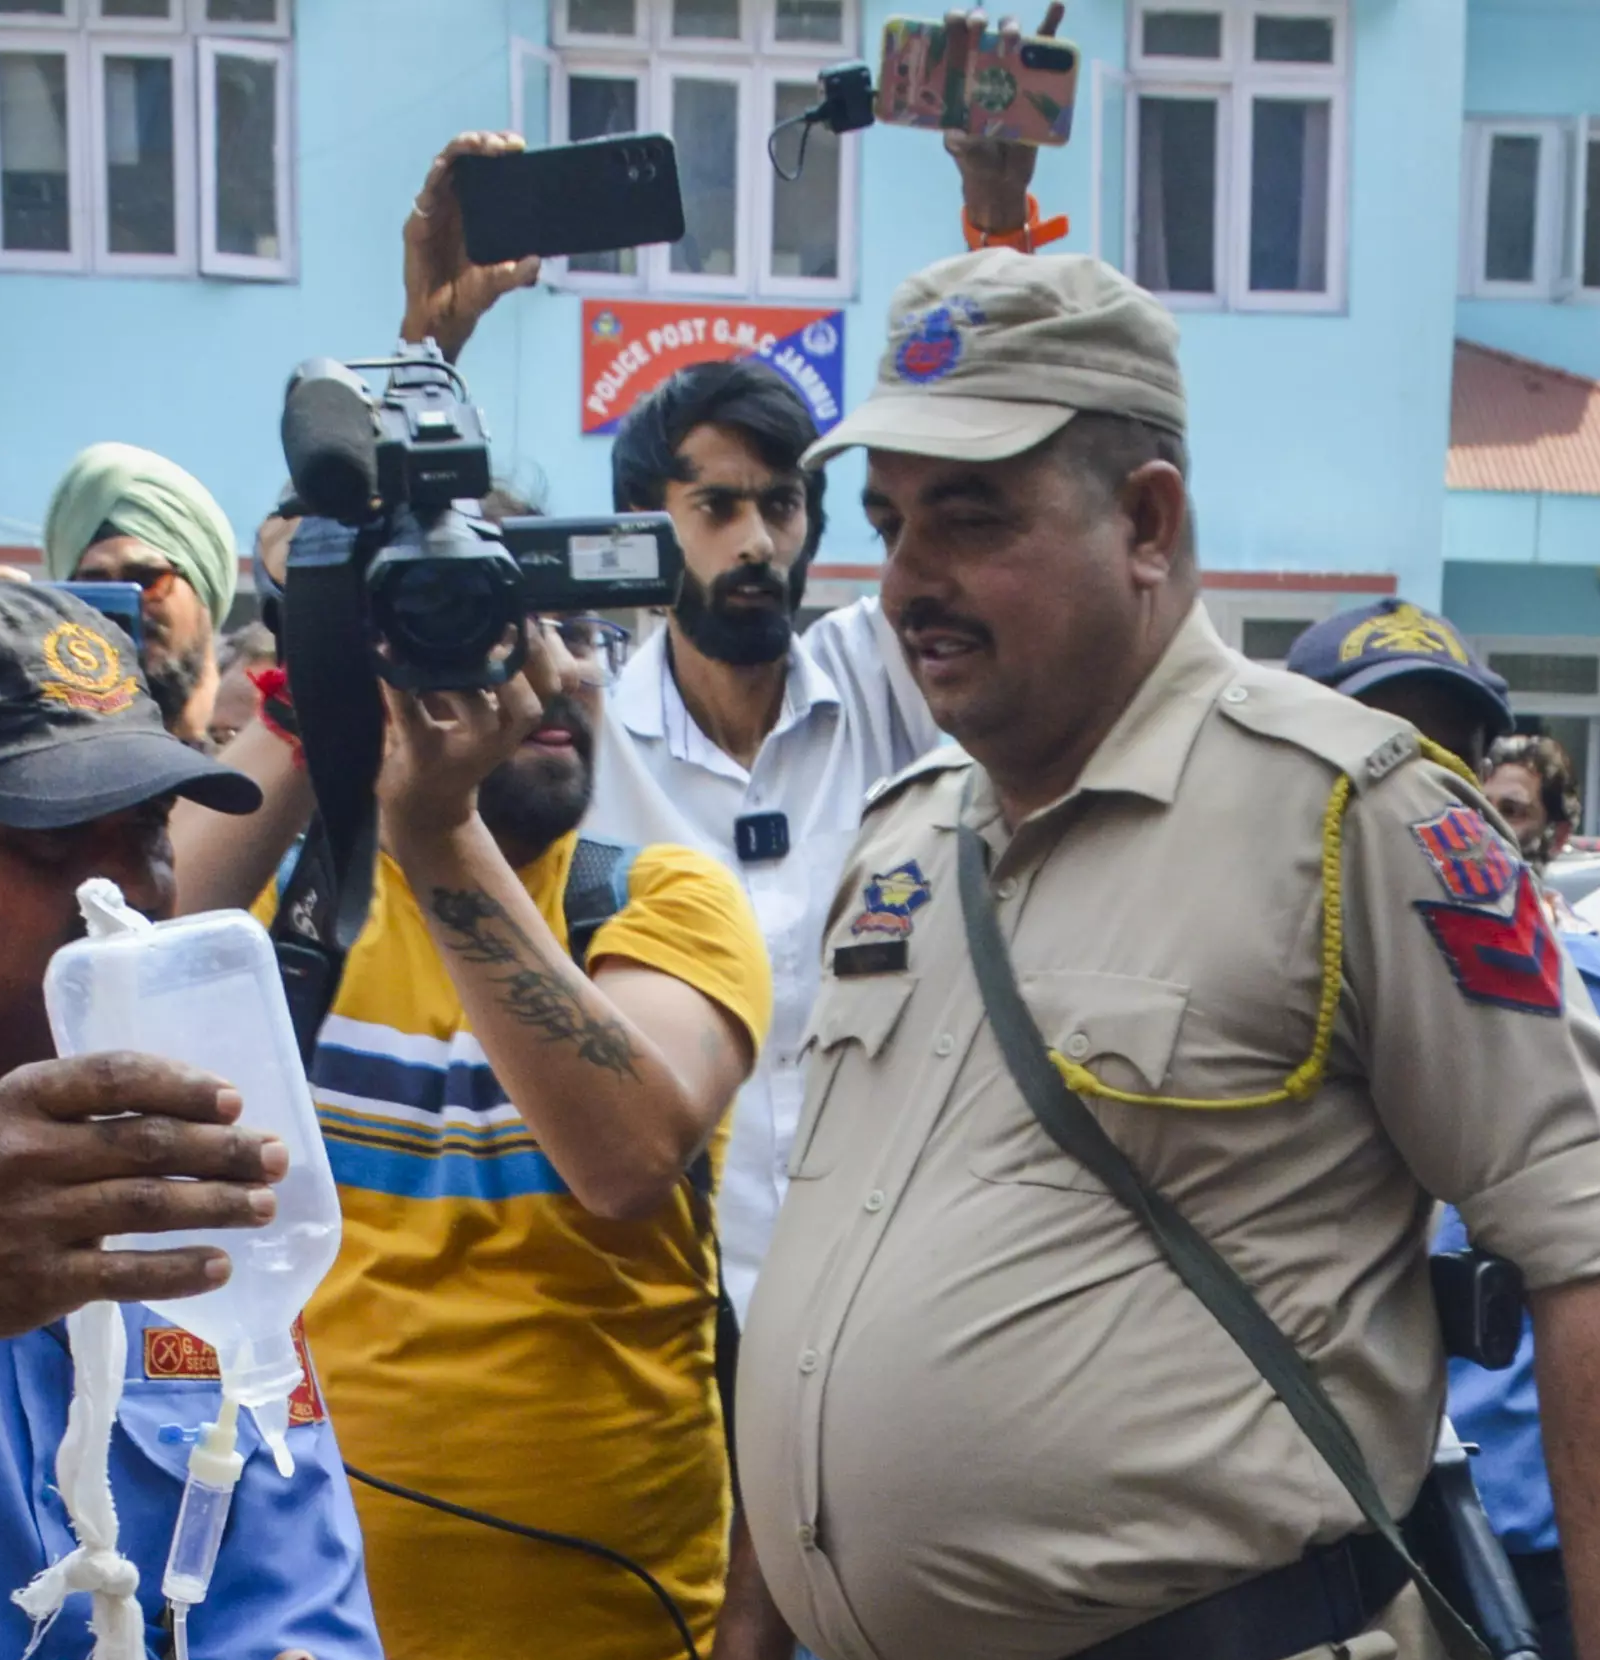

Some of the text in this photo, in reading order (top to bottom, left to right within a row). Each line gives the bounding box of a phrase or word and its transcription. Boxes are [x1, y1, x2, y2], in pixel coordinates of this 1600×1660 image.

[586, 340, 651, 417] POLICE
[647, 317, 707, 355] POST
[774, 346, 839, 420] JAMMU
[68, 639, 100, 671] S
